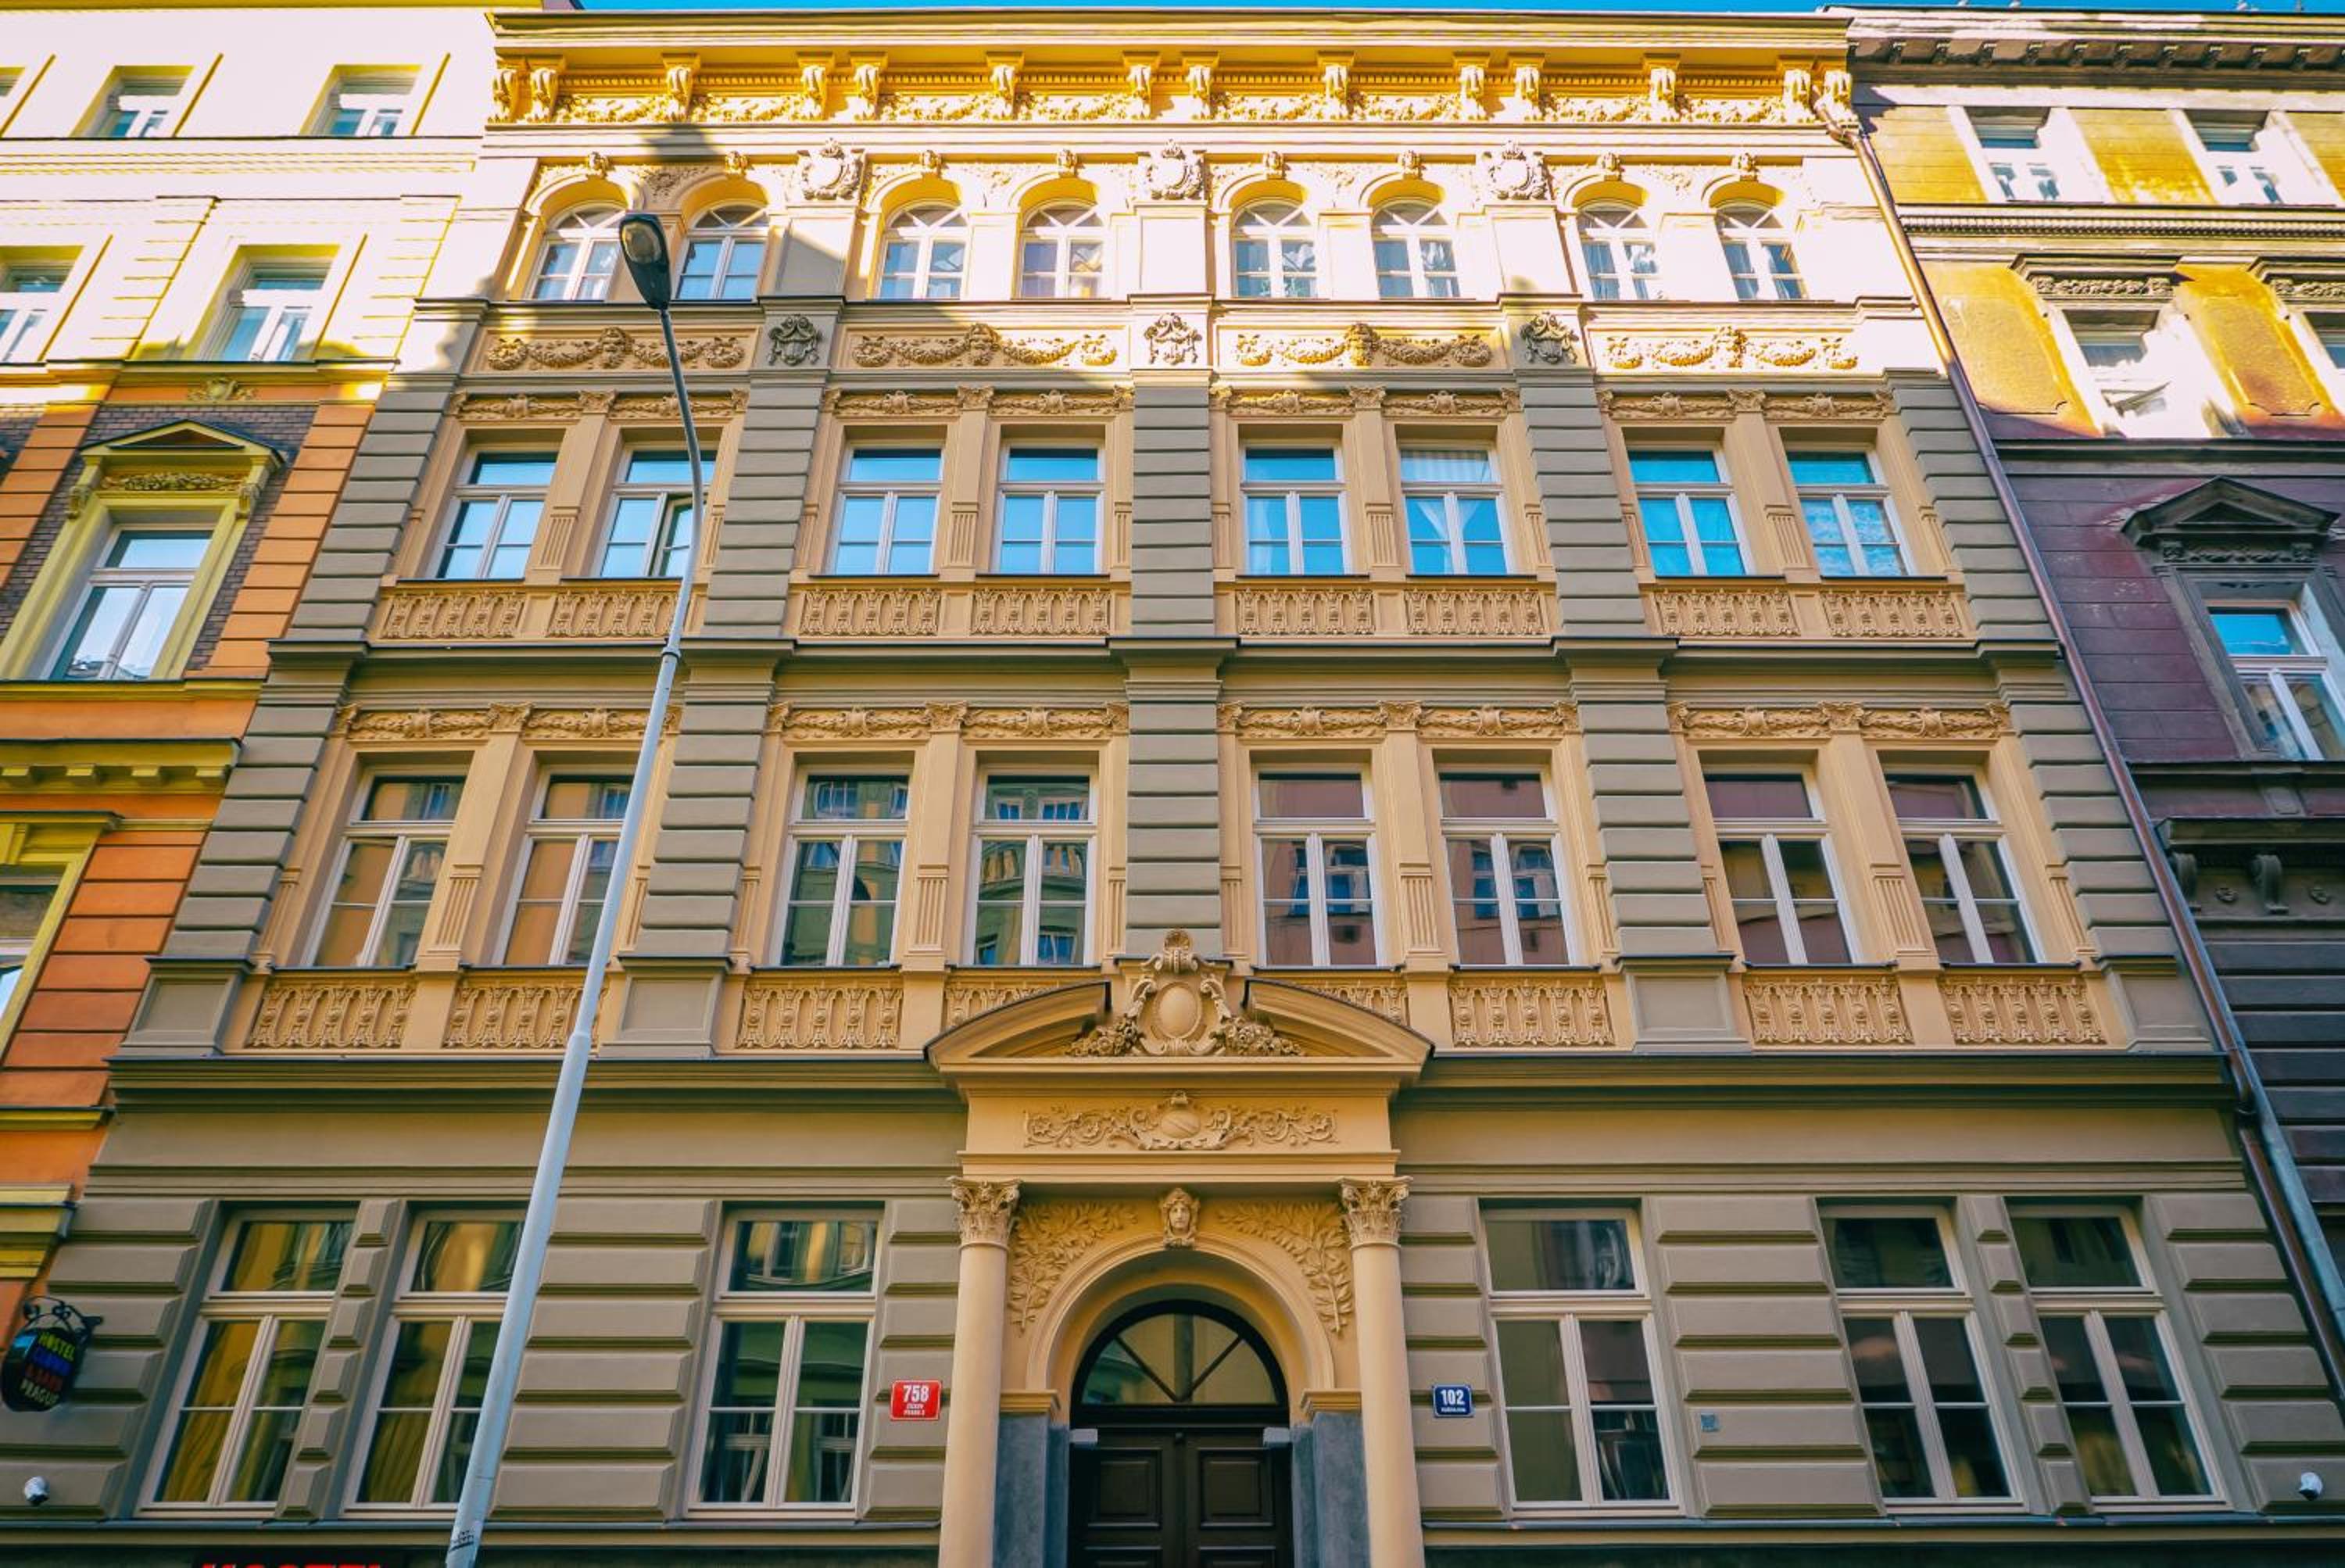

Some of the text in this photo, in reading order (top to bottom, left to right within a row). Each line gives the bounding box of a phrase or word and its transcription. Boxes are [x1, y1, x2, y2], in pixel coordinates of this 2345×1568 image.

[38, 1331, 76, 1362] HOSTEL
[20, 1378, 59, 1405] PRAGUE
[903, 1384, 929, 1403] 758
[1441, 1389, 1466, 1406] 102
